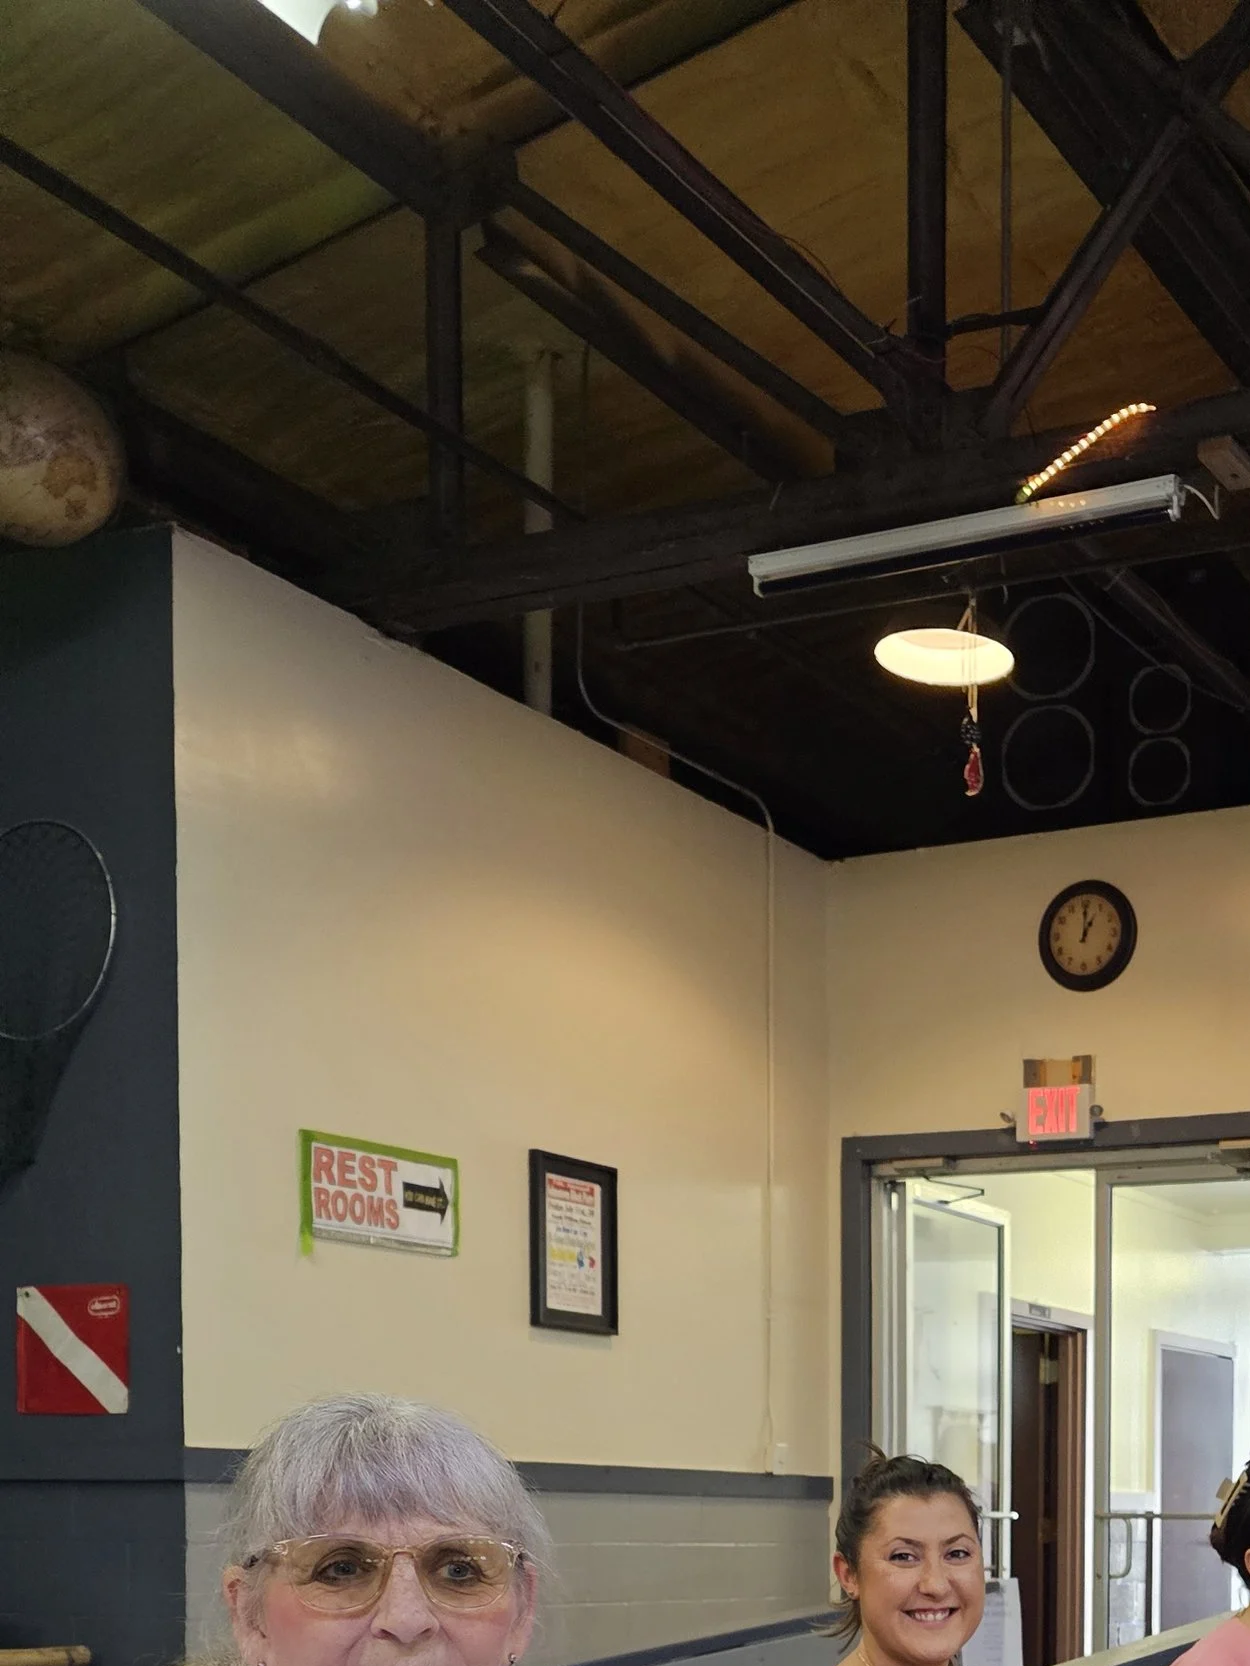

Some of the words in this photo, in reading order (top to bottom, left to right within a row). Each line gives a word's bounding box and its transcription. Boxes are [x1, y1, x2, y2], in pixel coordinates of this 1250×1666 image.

[1027, 1085, 1081, 1137] EXIT
[313, 1147, 398, 1196] REST
[313, 1186, 400, 1231] ROOMS
